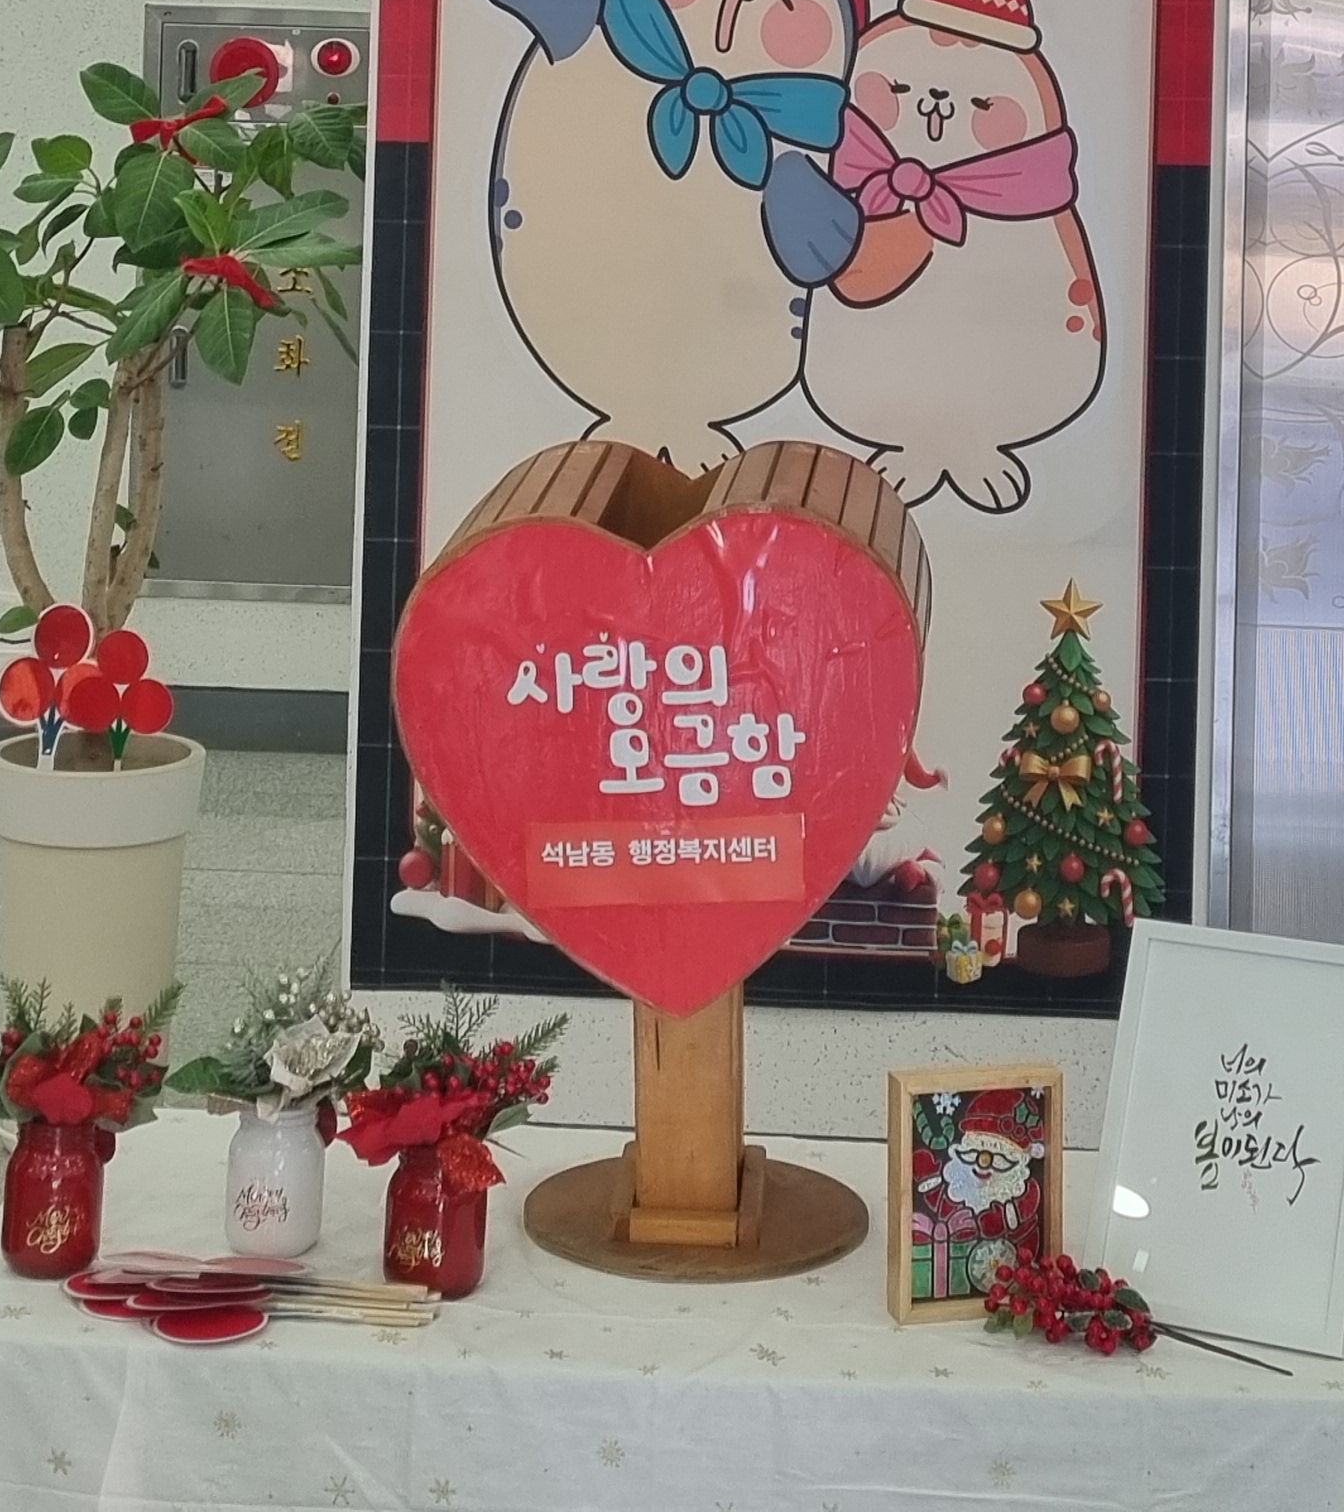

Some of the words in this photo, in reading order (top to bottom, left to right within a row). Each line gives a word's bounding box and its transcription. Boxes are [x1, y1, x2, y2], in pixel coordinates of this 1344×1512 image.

[506, 634, 729, 726] 사랑의
[598, 713, 806, 807] 모금함
[541, 838, 616, 869] 석남동
[627, 835, 778, 866] 행정복지센터
[1214, 1080, 1283, 1105] 미소가
